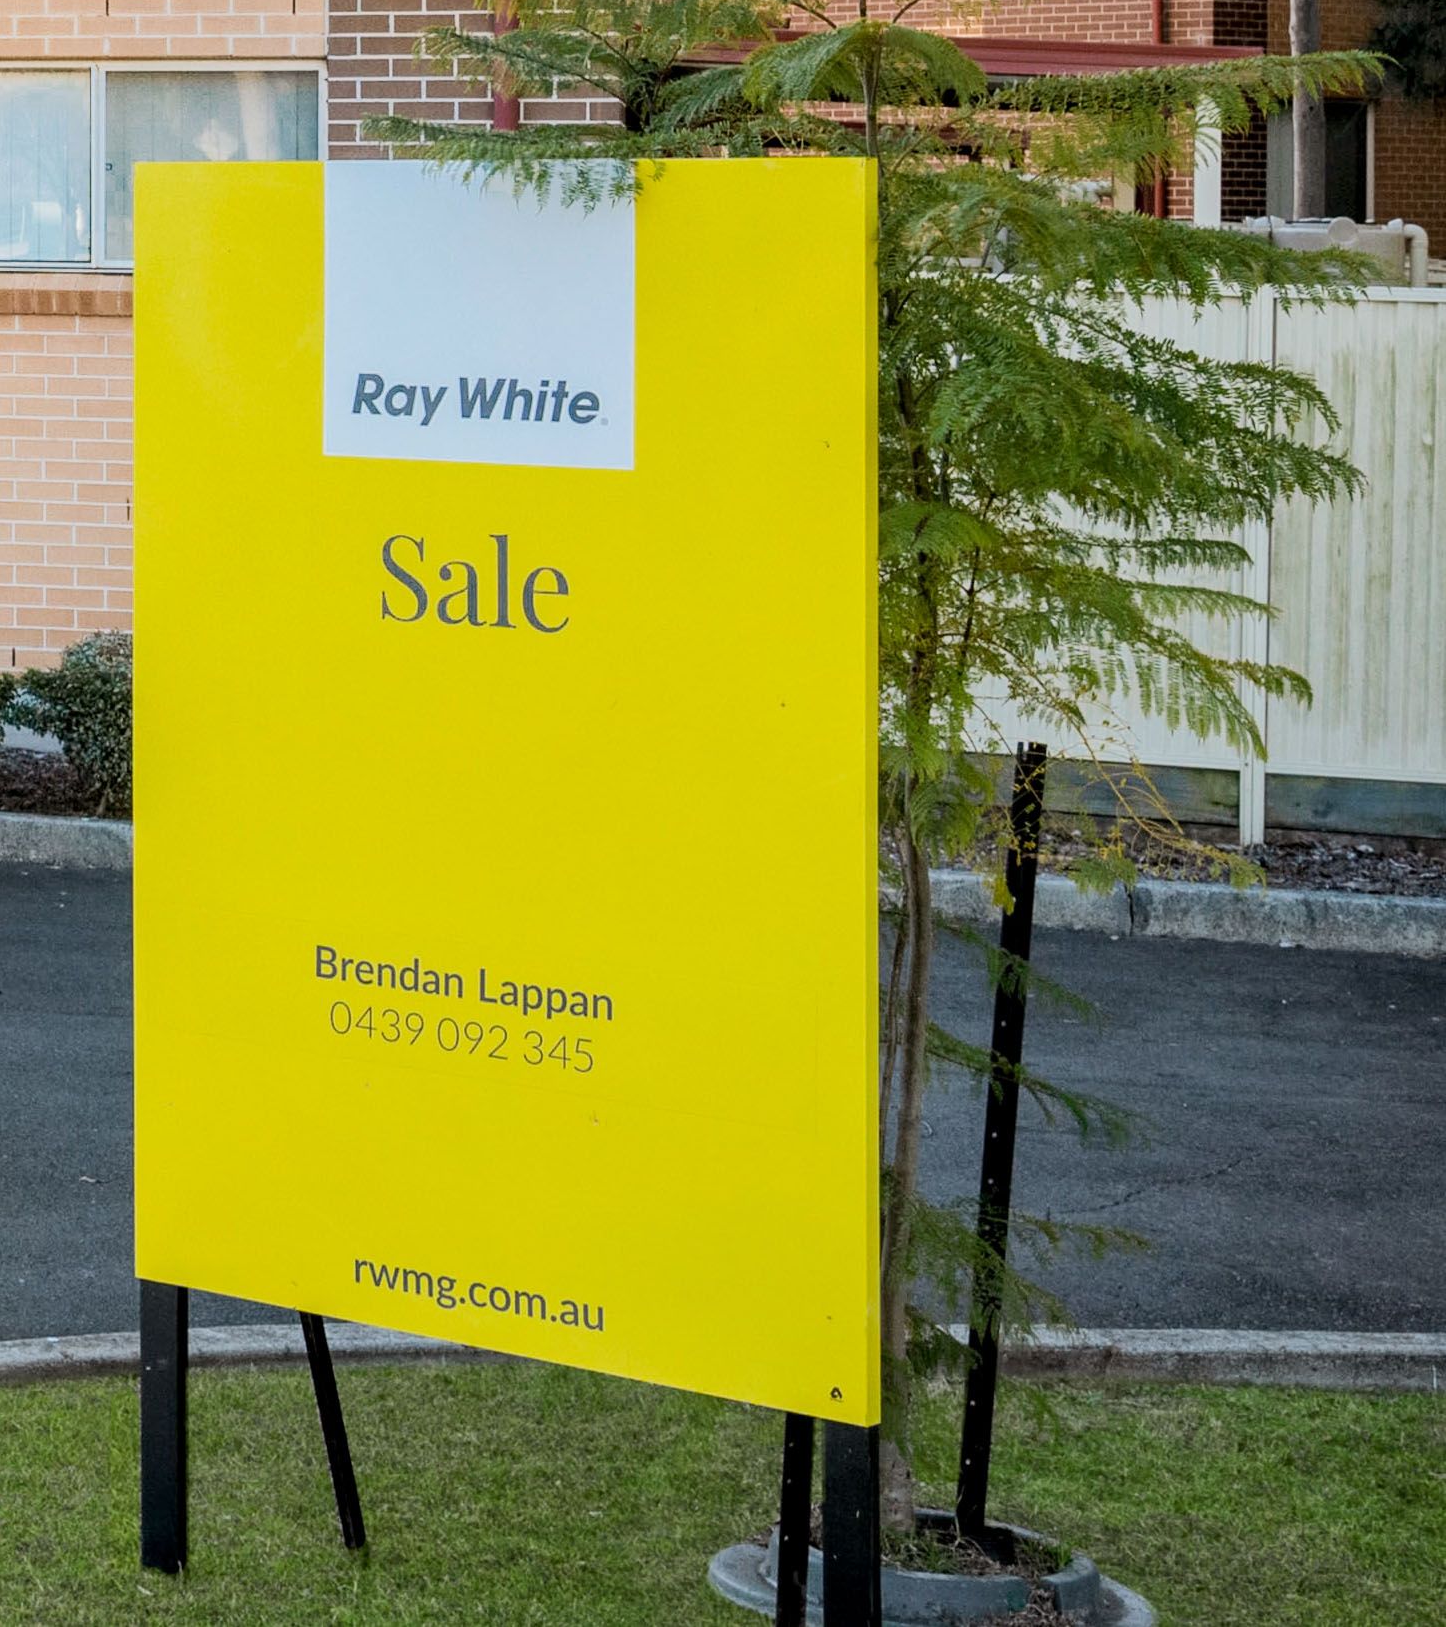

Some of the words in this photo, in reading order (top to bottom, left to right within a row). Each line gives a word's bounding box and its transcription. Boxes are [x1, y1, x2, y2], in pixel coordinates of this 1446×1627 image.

[352, 373, 448, 426] Ray
[459, 377, 600, 424] White
[381, 533, 570, 634] Sale
[315, 944, 464, 999] Brendan
[479, 968, 614, 1022] Lappan
[329, 1000, 425, 1046] 0439
[437, 1017, 509, 1061] 092
[523, 1030, 595, 1074] 345
[353, 1258, 605, 1332] rwmg.com.au
